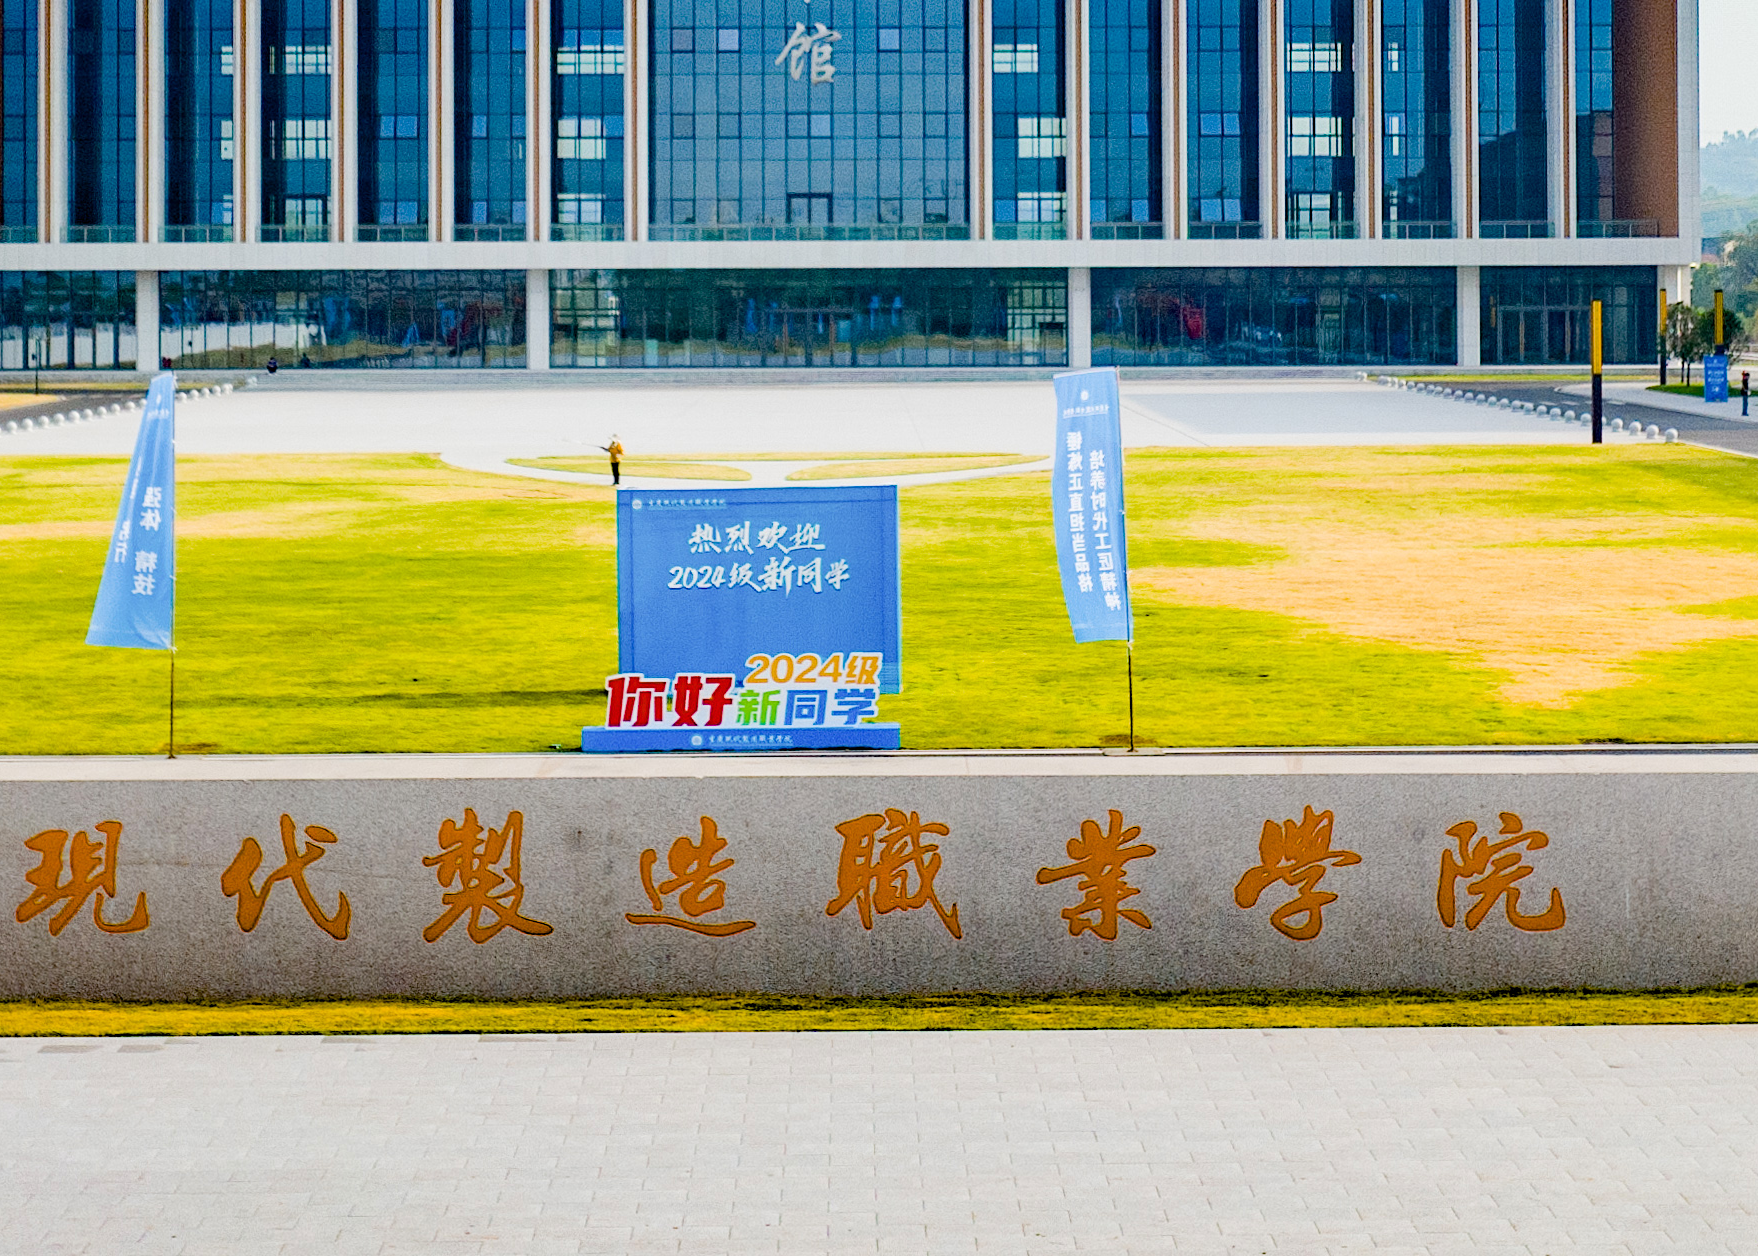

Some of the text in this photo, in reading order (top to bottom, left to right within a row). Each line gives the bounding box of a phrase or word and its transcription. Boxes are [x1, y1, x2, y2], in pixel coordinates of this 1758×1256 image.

[688, 520, 826, 555] 热烈欢迎
[667, 554, 851, 597] 2024级新同学
[745, 652, 880, 685] 2024级
[606, 675, 734, 728] 你好
[736, 687, 877, 726] 新同学
